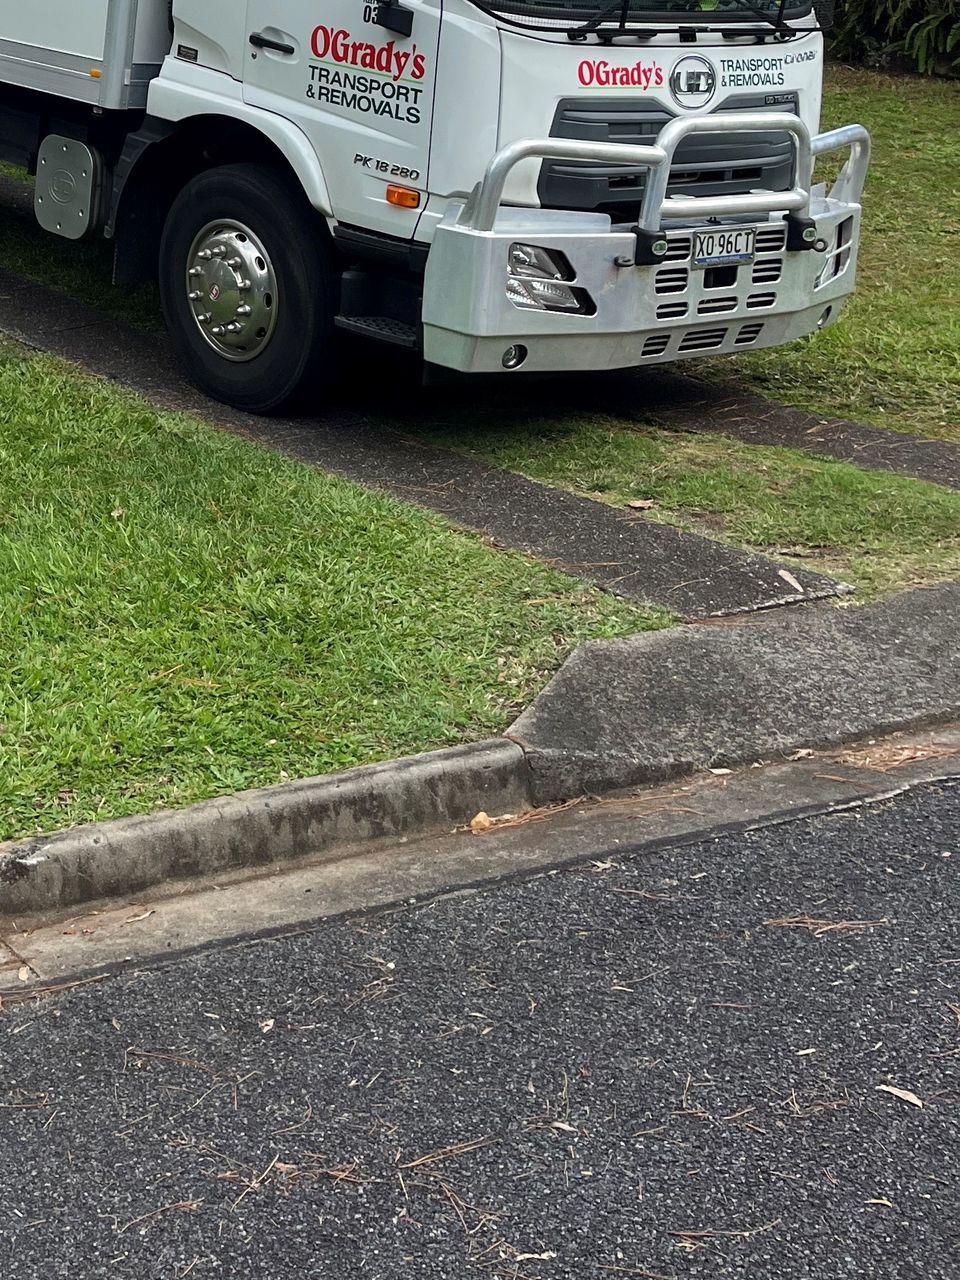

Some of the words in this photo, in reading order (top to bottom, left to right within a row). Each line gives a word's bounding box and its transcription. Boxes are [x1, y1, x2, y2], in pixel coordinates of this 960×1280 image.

[310, 25, 426, 81] O'Grady's
[720, 58, 783, 72] TRANSPORT
[308, 65, 423, 105] TRANSPORT
[577, 60, 663, 91] O'Grady's
[721, 75, 727, 87] &
[728, 73, 785, 87] REMOVALS
[306, 84, 316, 99] &
[318, 86, 421, 124] REMOVALS
[353, 153, 373, 169] PK
[375, 159, 390, 173] 18
[390, 164, 420, 181] 280
